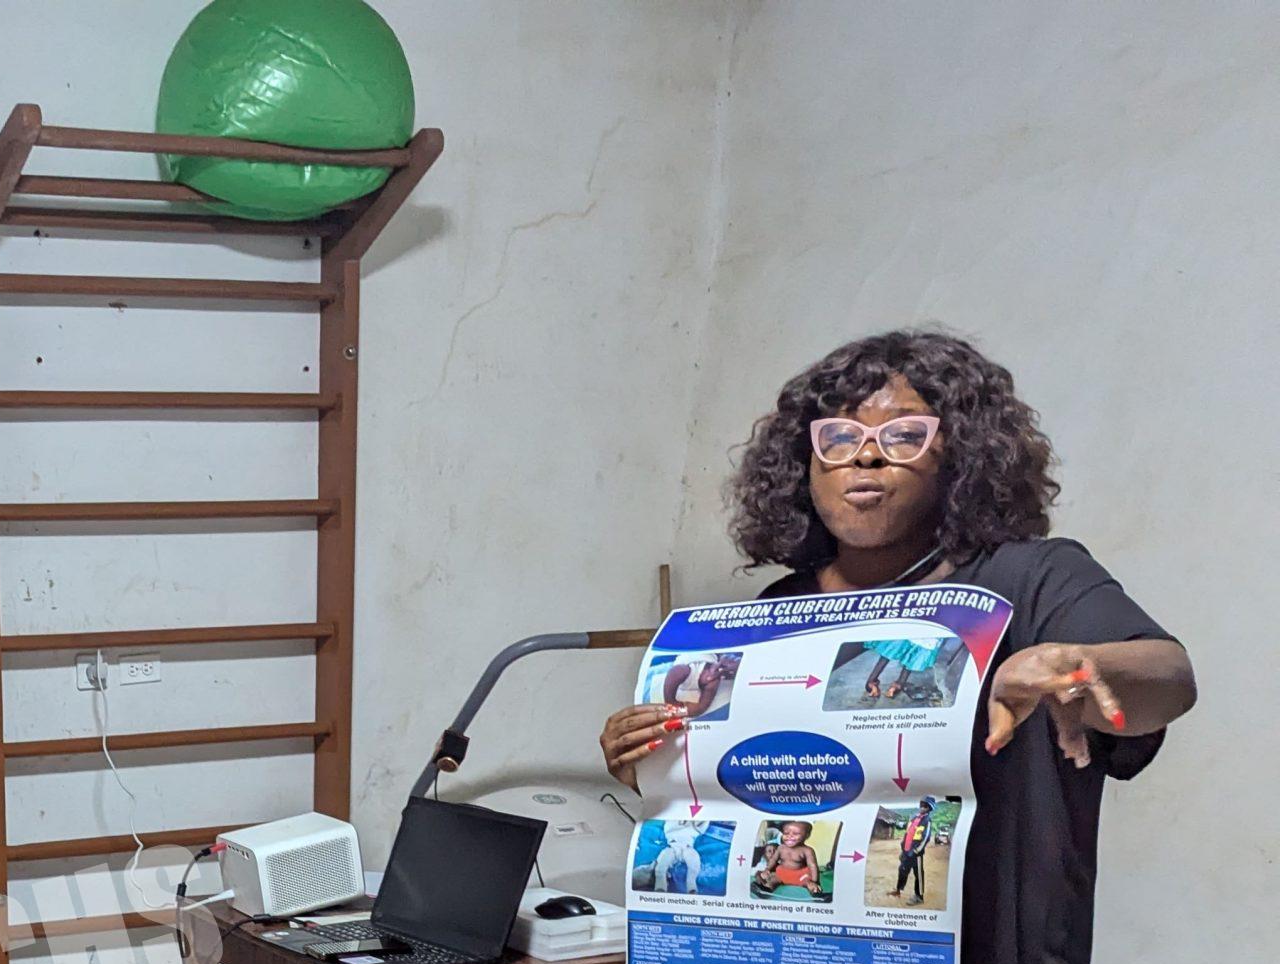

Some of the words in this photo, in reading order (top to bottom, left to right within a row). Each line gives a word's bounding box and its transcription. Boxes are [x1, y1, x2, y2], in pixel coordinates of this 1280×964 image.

[688, 604, 773, 623] CAMEROON
[773, 597, 857, 616] CLUBFOOT
[858, 593, 904, 610] CARE
[905, 590, 997, 613] PROGRAM
[714, 617, 773, 629] CLUBFOOT:
[775, 614, 811, 625] EARLY
[815, 609, 883, 623] TREATMENT
[884, 609, 900, 618] IS
[901, 606, 937, 617] BEST!
[852, 714, 891, 722] Neglected
[913, 721, 948, 730] possible
[730, 755, 739, 766] A
[741, 754, 769, 766] child
[771, 754, 796, 766] with
[799, 753, 850, 765] clubfoot
[752, 768, 794, 780] treated
[797, 768, 827, 781] early
[745, 782, 765, 792] will
[768, 784, 797, 793] grow
[800, 782, 812, 791] to
[815, 781, 843, 792] walk
[771, 793, 821, 806] normally
[639, 895, 666, 903] Ponseti
[806, 906, 834, 915] Braces
[865, 910, 885, 919] After
[887, 912, 927, 921] treatment
[673, 915, 701, 924] CLINICS
[704, 918, 741, 927] OFFERING
[743, 920, 759, 929] THE
[761, 921, 794, 931] PONSETI
[797, 923, 830, 933] METHOD
[831, 926, 844, 934] OF
[846, 927, 894, 938] TREATMENT
[884, 919, 917, 927] clubfoot
